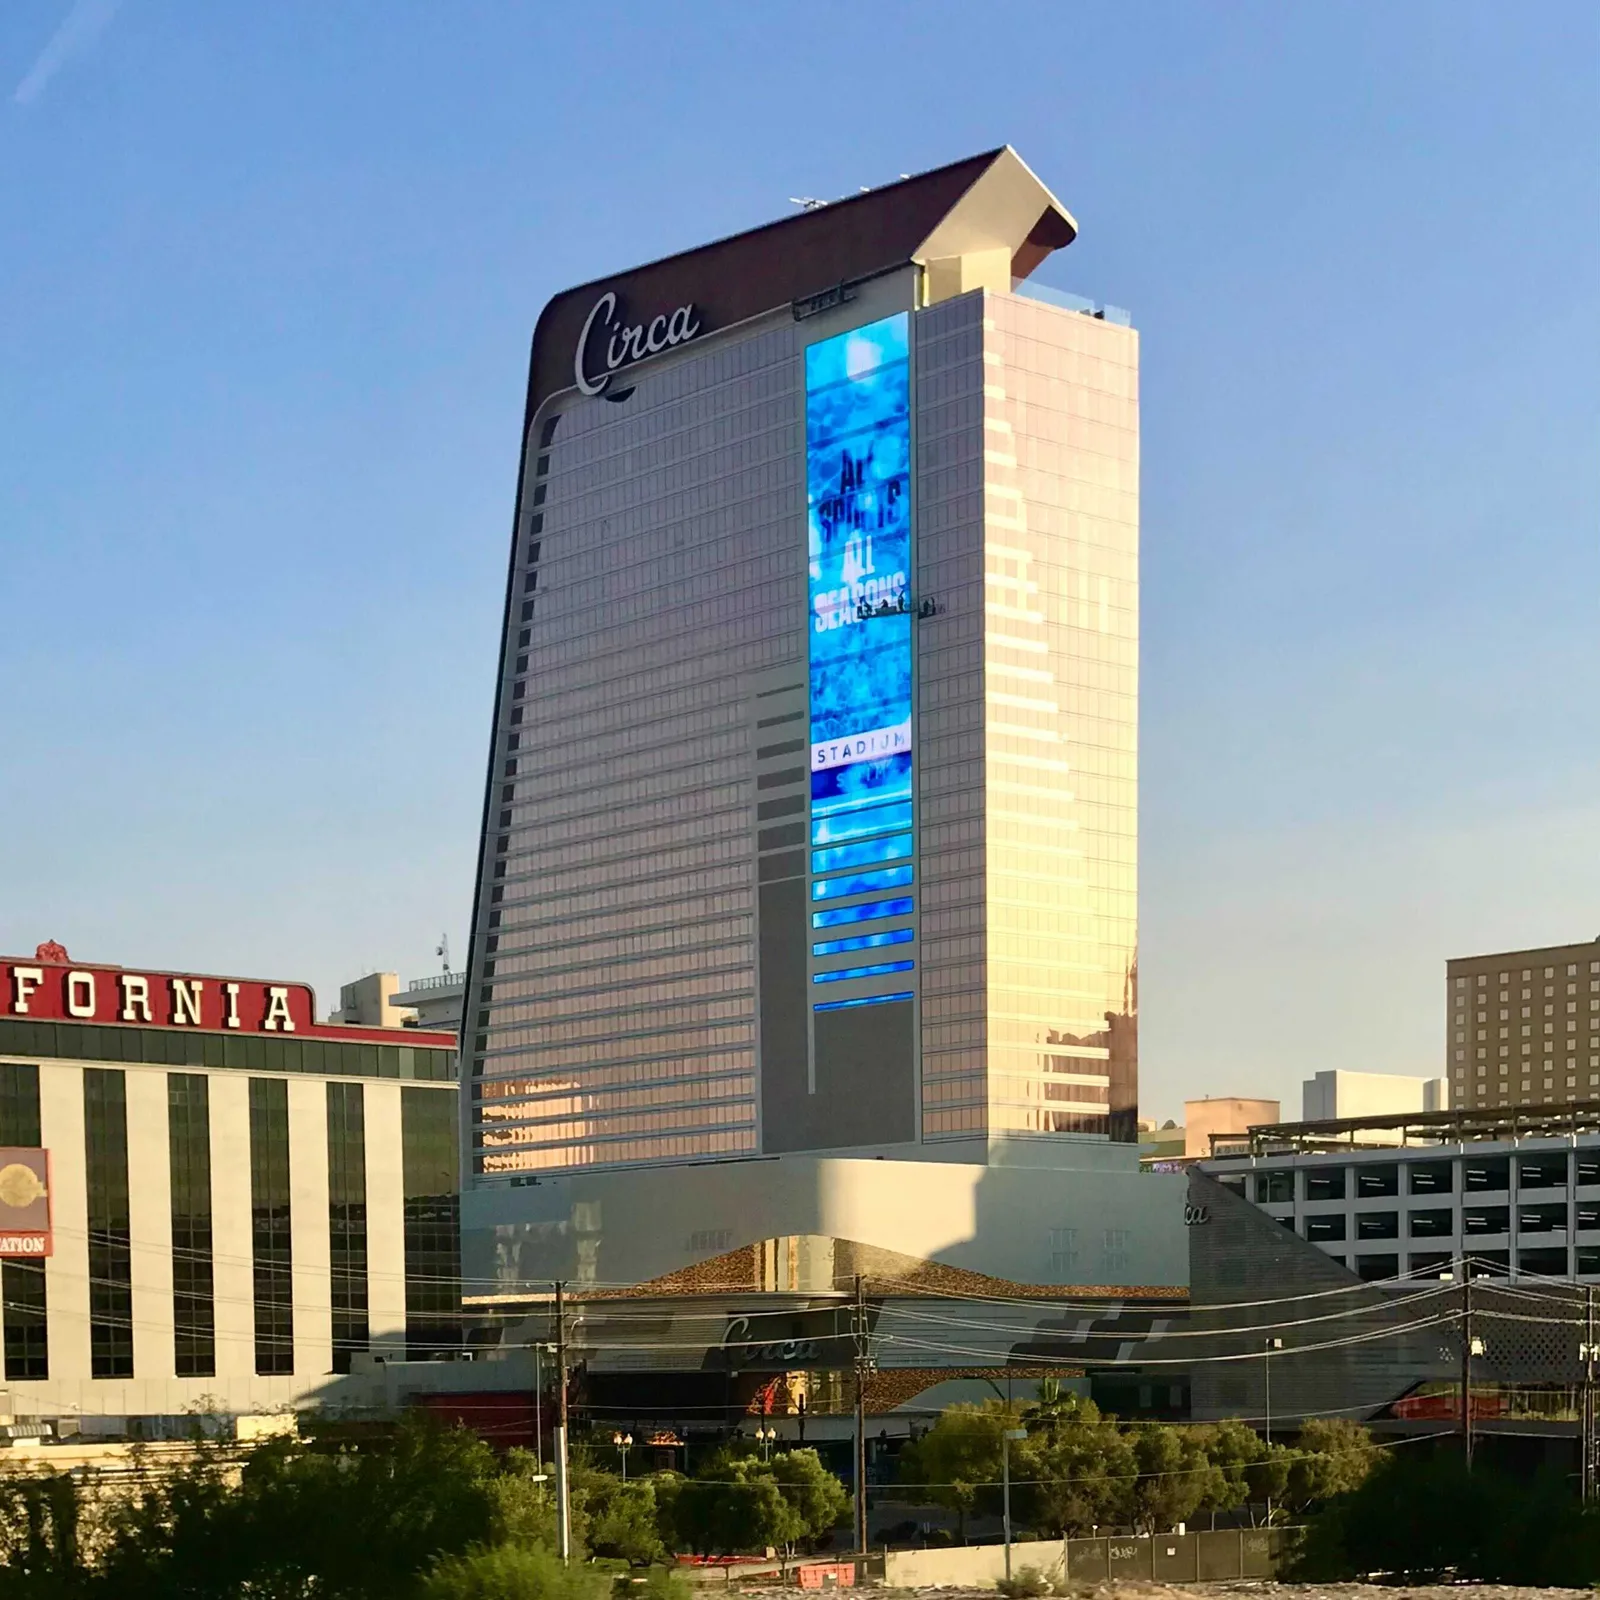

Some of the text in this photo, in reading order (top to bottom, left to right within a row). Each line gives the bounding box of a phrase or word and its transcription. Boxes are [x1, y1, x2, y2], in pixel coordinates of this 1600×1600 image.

[575, 292, 700, 395] Circa
[818, 478, 902, 543] SPOTS
[817, 732, 905, 763] STADIUM
[14, 967, 295, 1031] FORNIA
[0, 1237, 45, 1252] ATION
